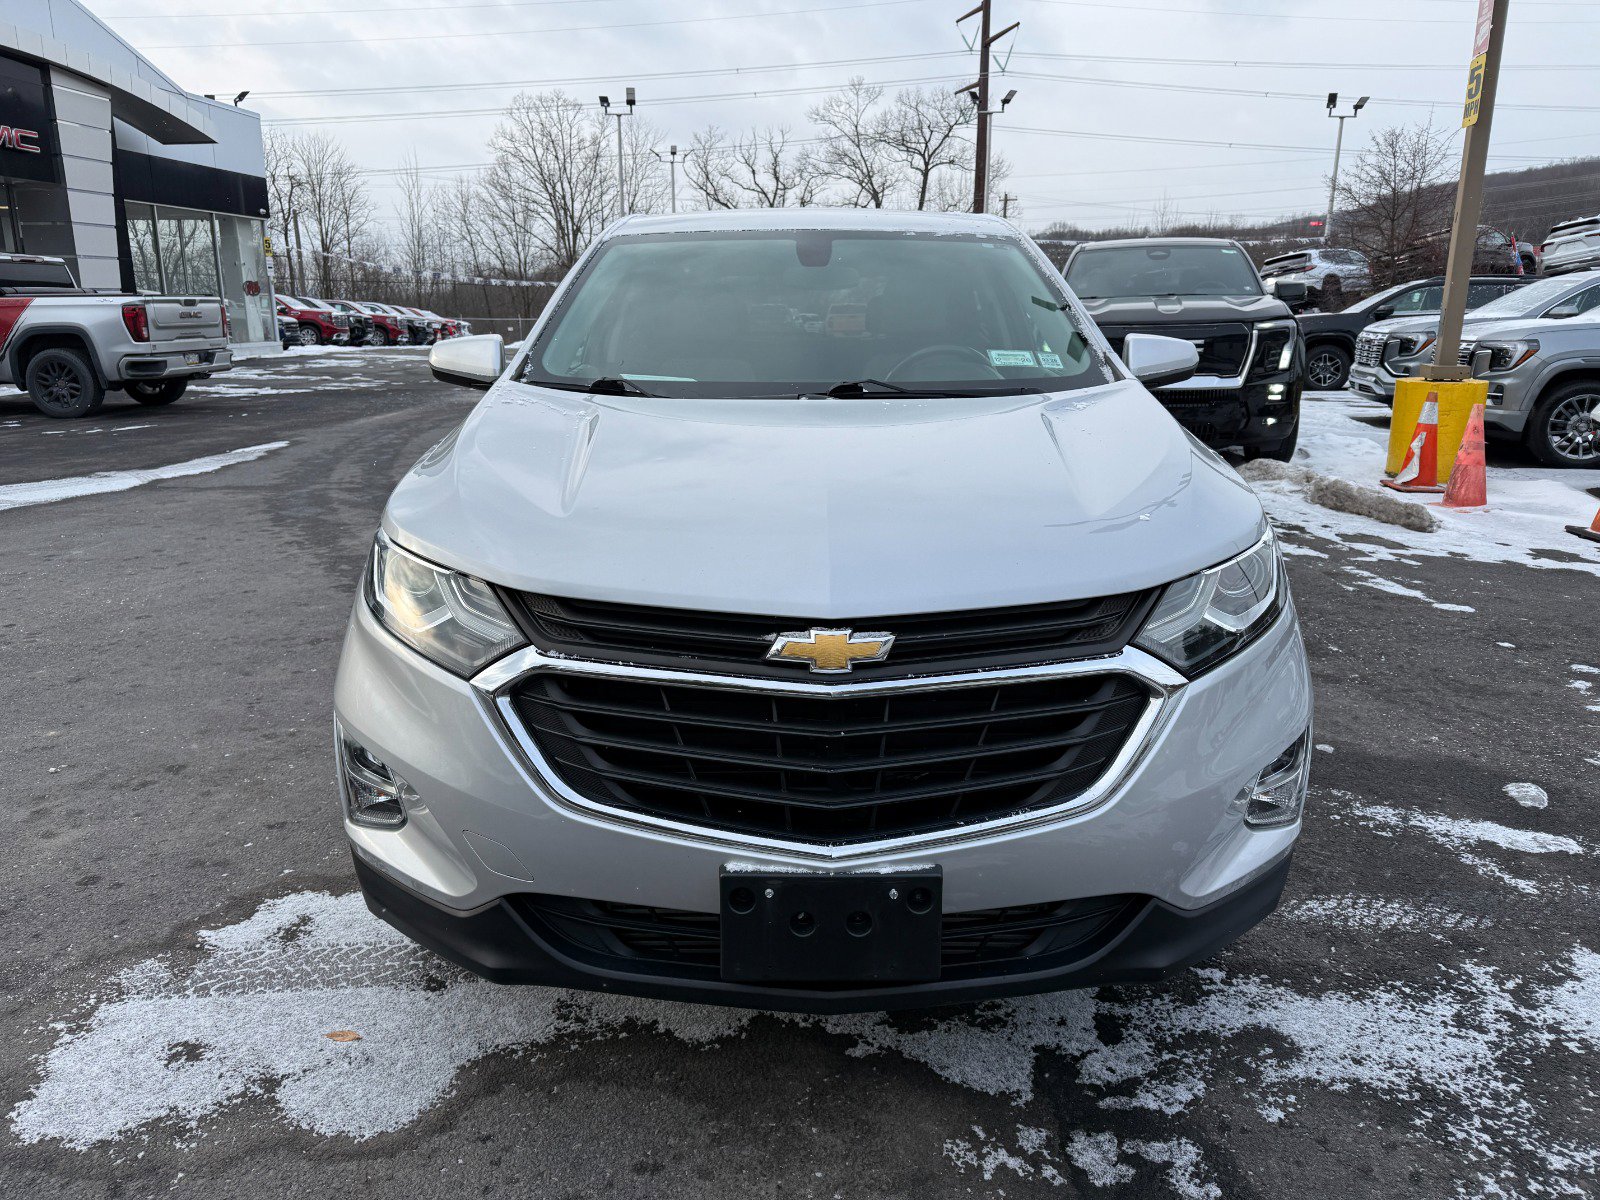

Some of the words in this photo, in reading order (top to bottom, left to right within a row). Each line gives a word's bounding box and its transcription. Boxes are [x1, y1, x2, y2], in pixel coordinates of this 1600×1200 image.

[1468, 63, 1483, 100] 5
[1463, 99, 1480, 119] MPH
[264, 239, 271, 249] 5
